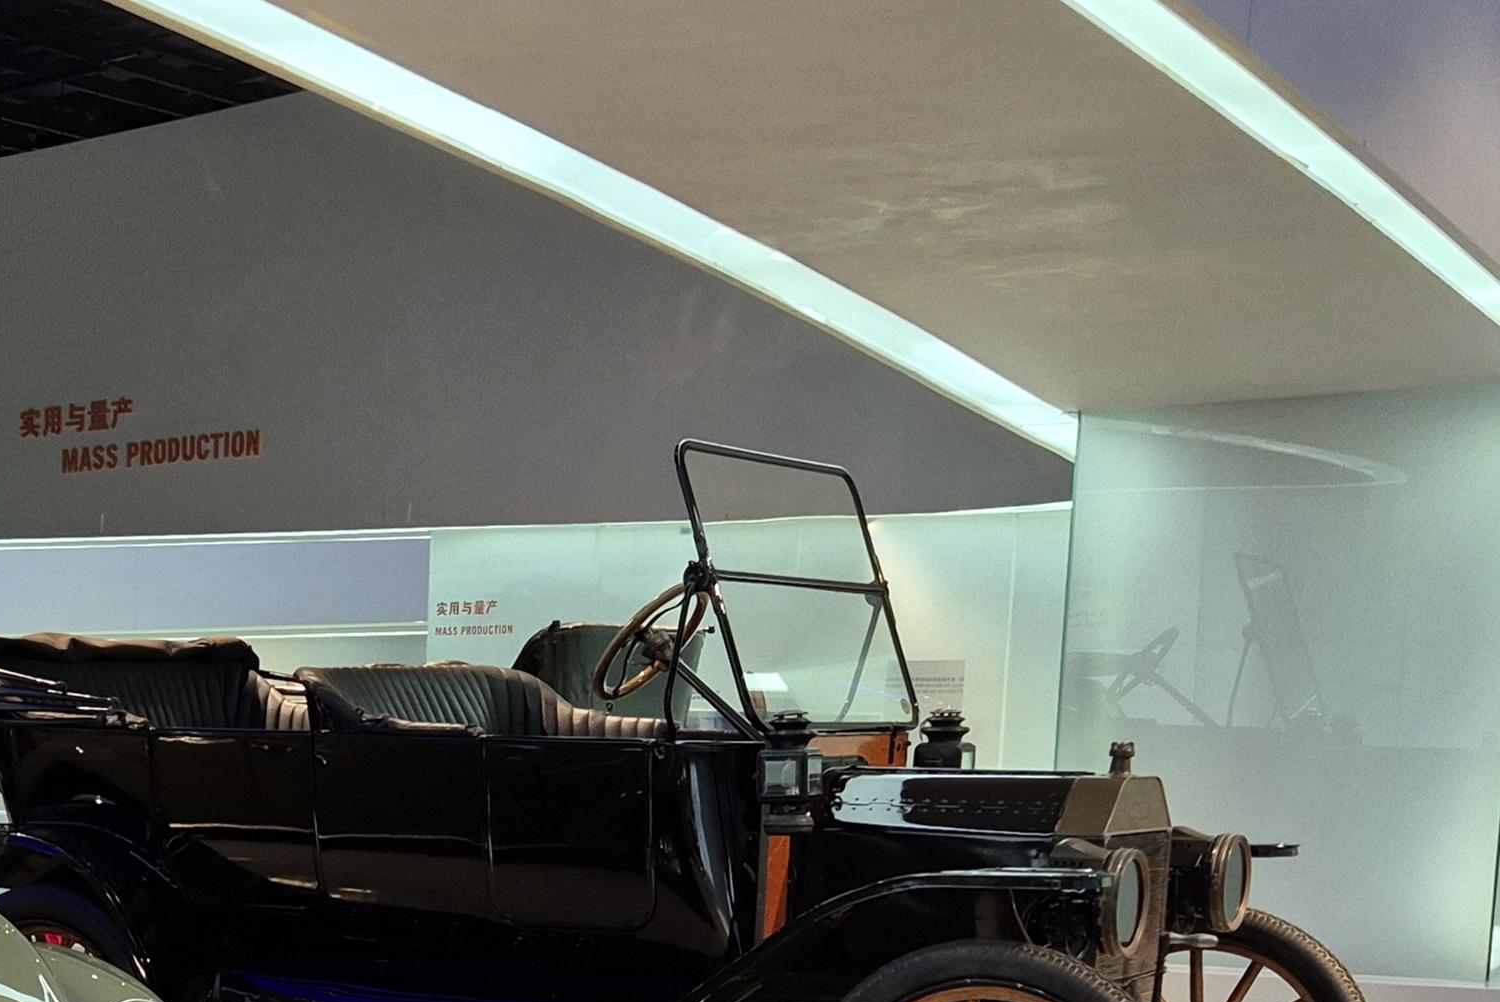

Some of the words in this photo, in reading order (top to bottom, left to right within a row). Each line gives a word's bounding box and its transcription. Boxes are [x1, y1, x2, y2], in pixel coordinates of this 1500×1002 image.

[19, 396, 134, 438] 实用与量产
[61, 443, 119, 473] MASS
[126, 429, 261, 467] PRODUCTION
[436, 600, 498, 616] 实用与量产
[435, 626, 458, 636] MASS
[460, 624, 514, 636] PRODUCTION
